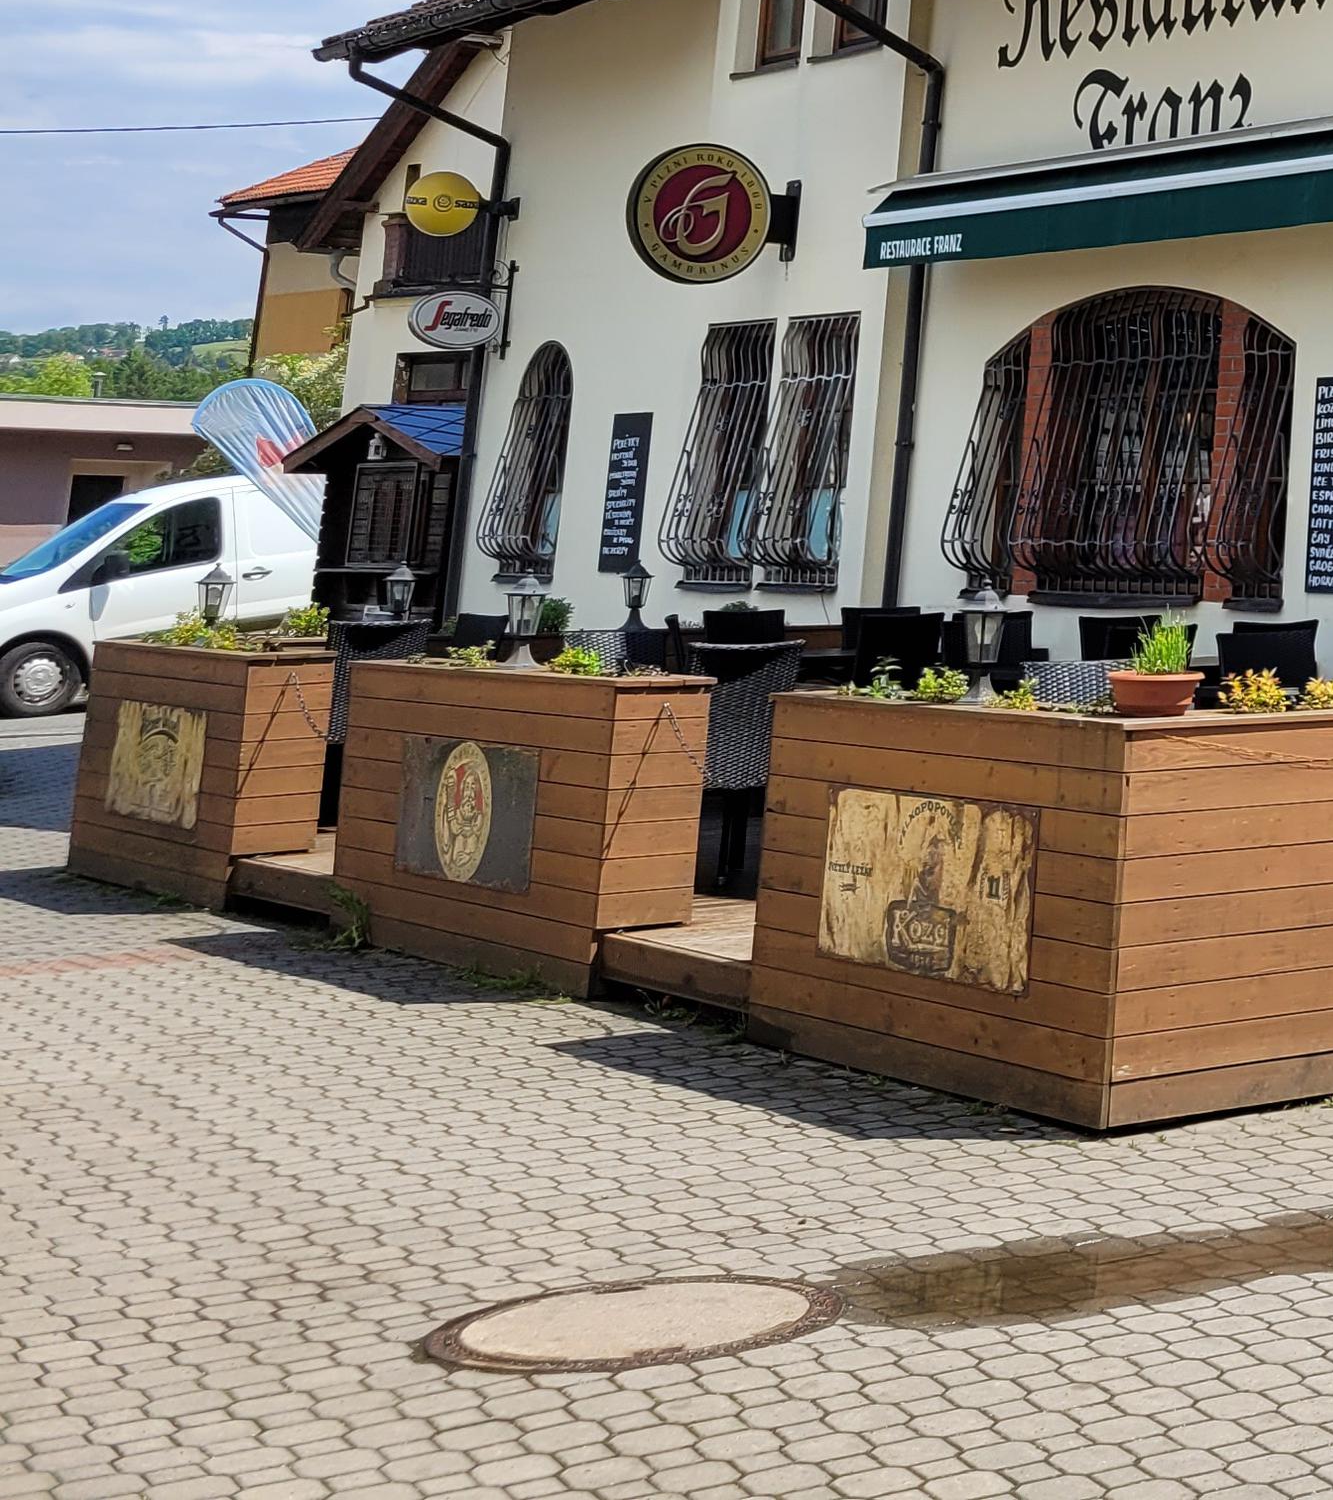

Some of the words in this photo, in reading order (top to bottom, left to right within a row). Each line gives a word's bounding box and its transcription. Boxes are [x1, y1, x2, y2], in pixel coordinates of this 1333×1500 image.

[651, 242, 750, 275] GAMBRINUS
[880, 236, 932, 261] RESTAURACE
[933, 233, 963, 255] FRANZ
[424, 300, 493, 332] Segafredo
[1312, 476, 1328, 486] ICE
[891, 909, 950, 947] Kozel
